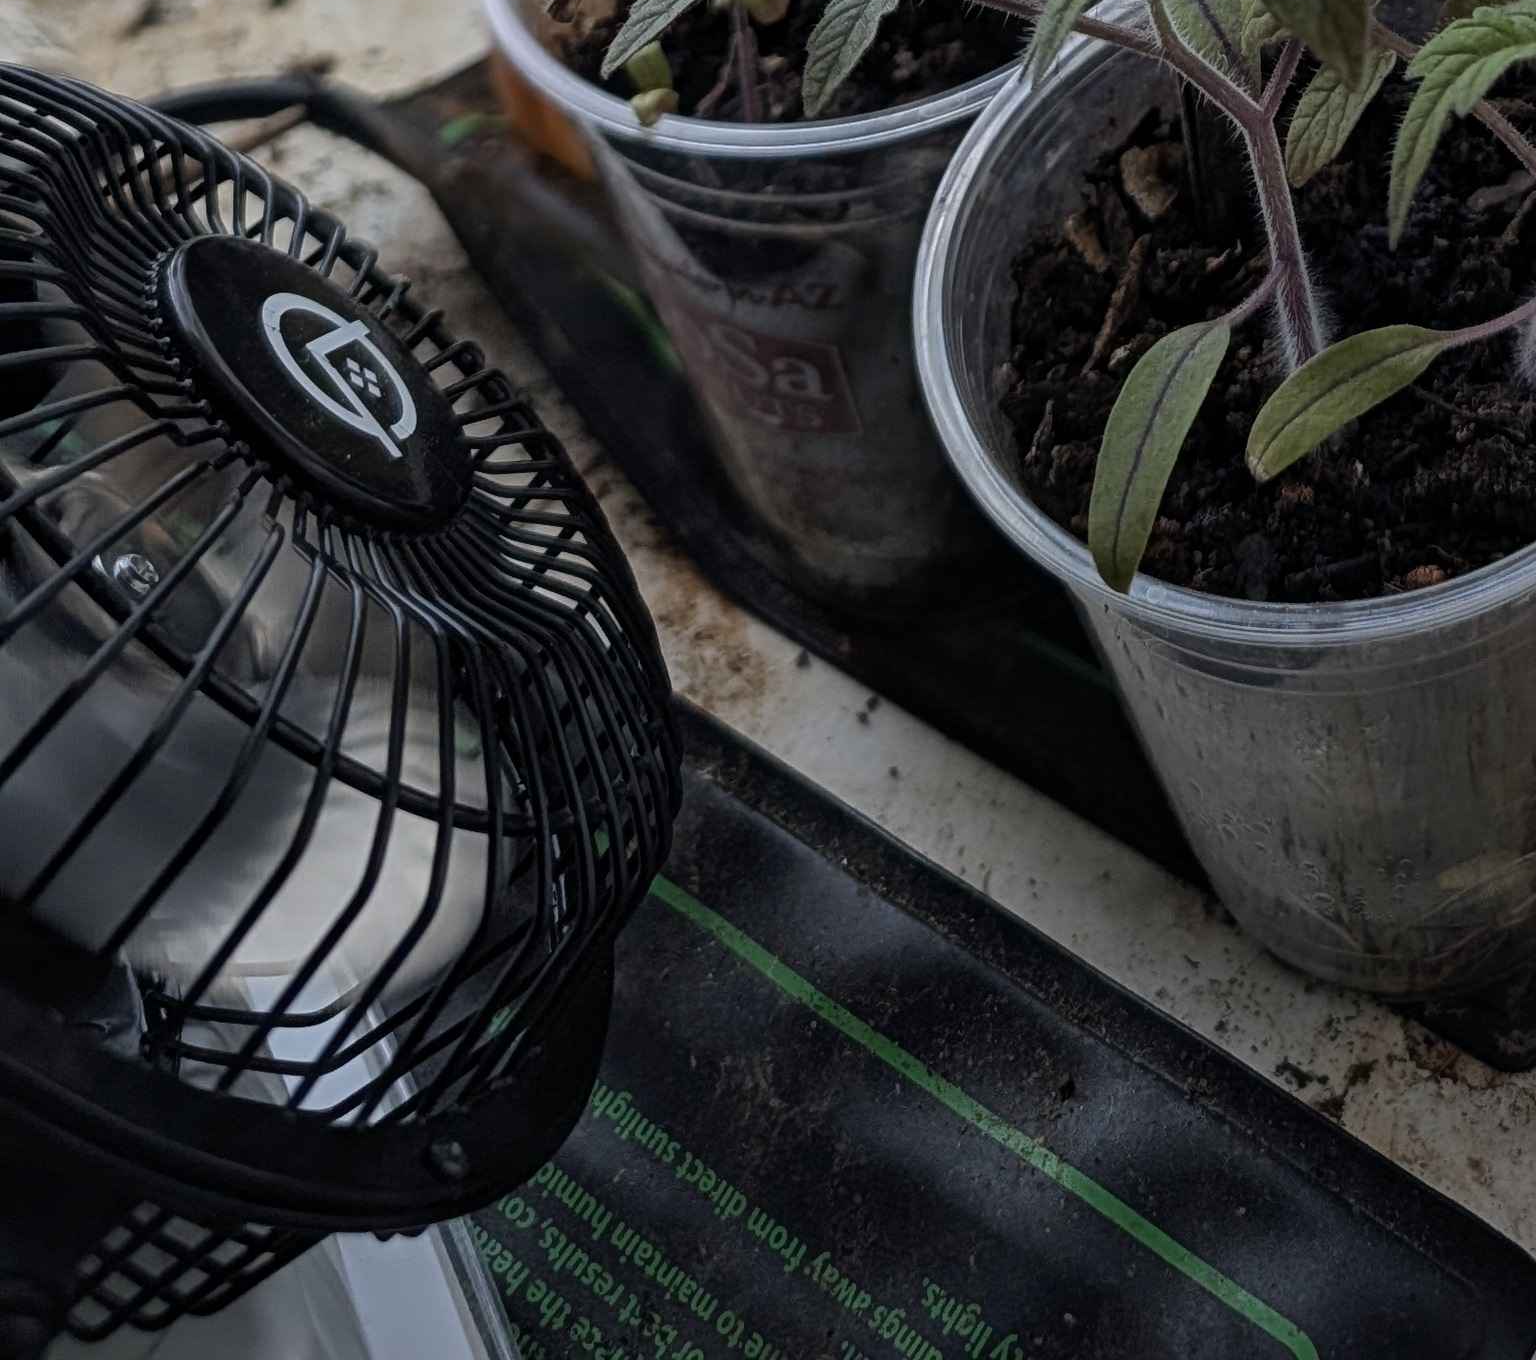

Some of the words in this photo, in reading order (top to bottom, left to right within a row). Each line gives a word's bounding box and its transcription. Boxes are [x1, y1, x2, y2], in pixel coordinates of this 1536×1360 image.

[591, 1081, 681, 1163] sunligh
[675, 1151, 747, 1220] direct
[540, 1219, 624, 1306] results,
[611, 1222, 718, 1320] maintain
[747, 1207, 807, 1274] from
[526, 1279, 571, 1330] the
[810, 1251, 872, 1315] away
[717, 1310, 744, 1347] to
[921, 1277, 993, 1360] lights.
